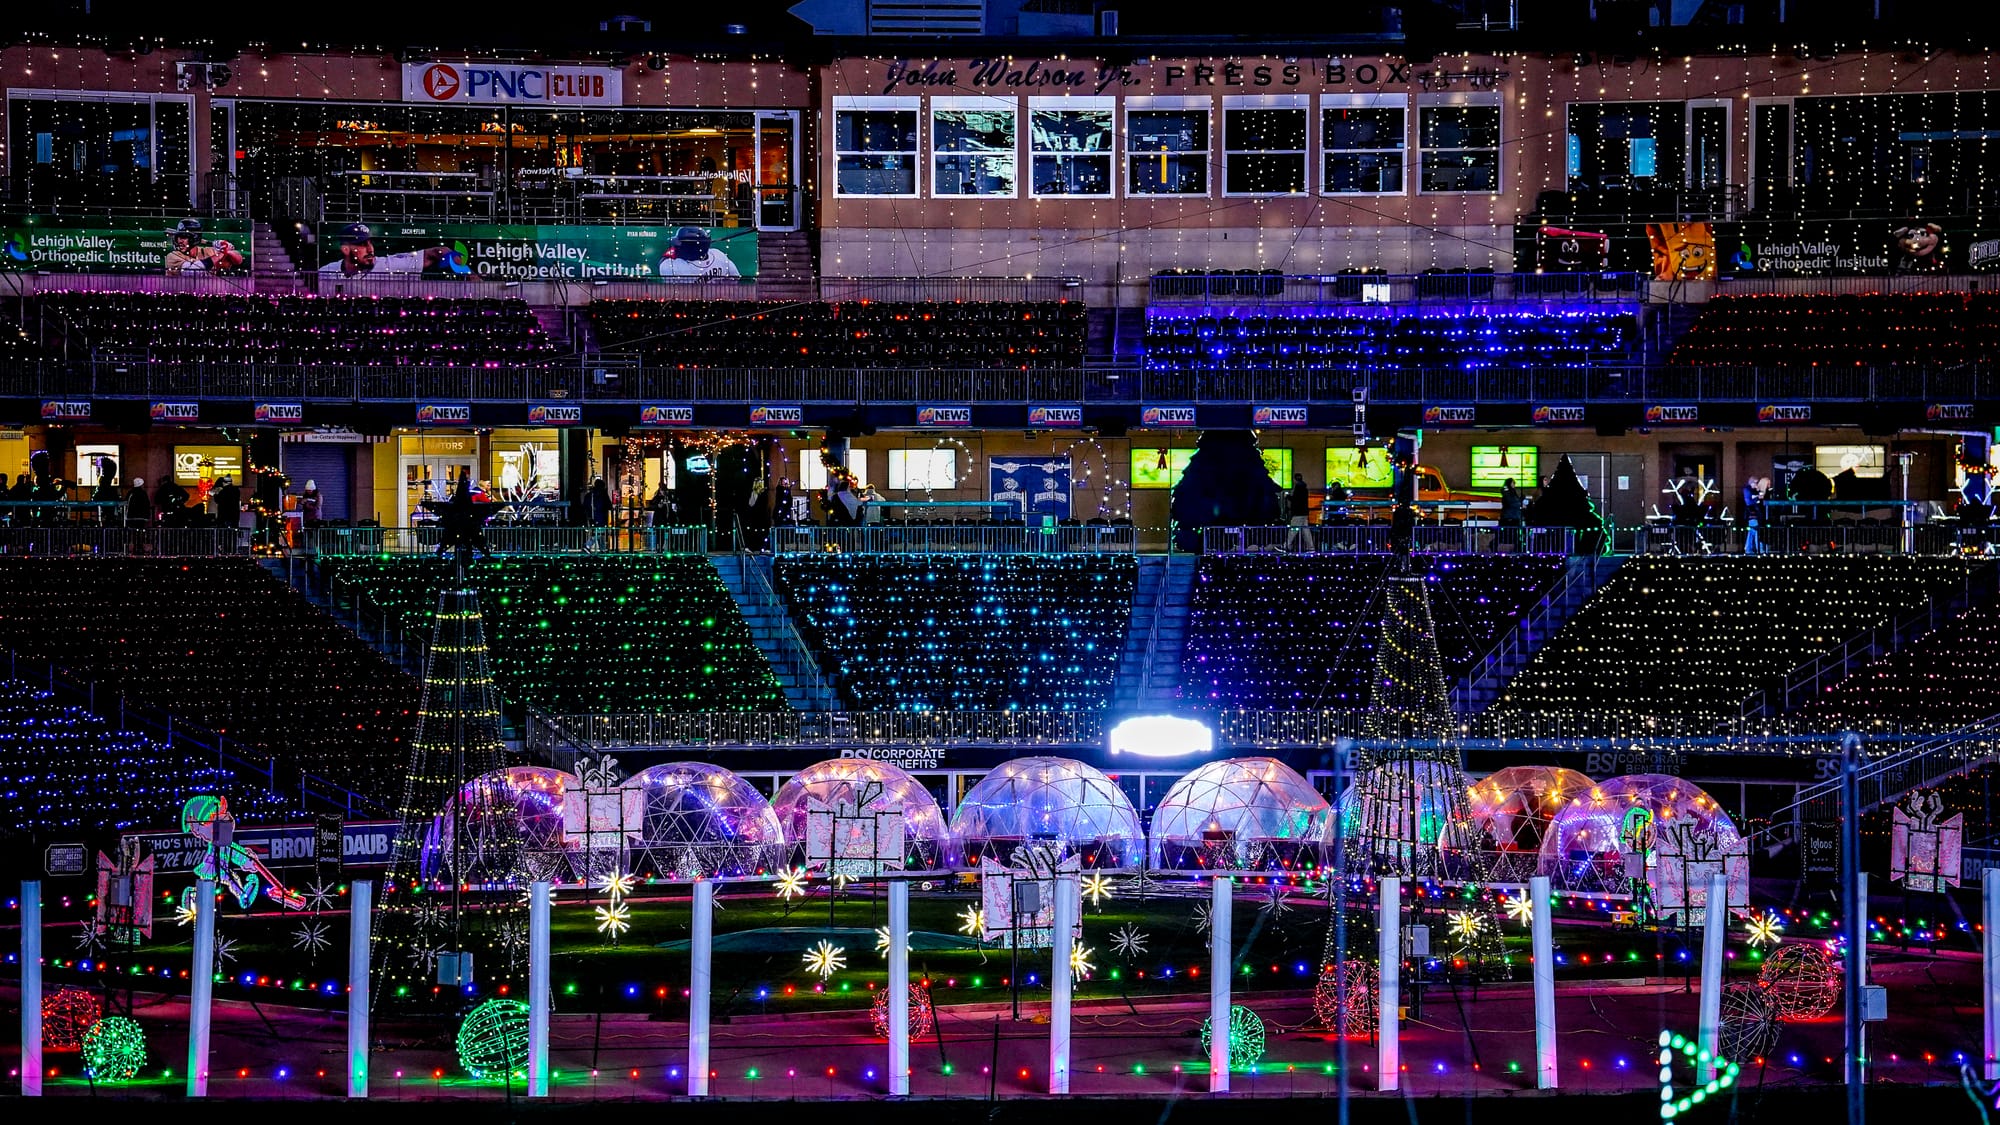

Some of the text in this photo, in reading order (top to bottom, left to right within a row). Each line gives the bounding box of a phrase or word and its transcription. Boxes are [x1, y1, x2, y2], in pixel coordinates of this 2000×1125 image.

[881, 58, 1142, 96] John Walson Jr.
[1165, 63, 1410, 87] PRESS BOX
[464, 69, 604, 99] PNC CLUB
[31, 235, 114, 250] Lehigh Valley
[31, 249, 161, 264] Orthopedic Institute
[476, 242, 587, 262] Lehigh Valley
[1757, 243, 1840, 257] Lehigh Valley
[477, 261, 652, 278] Orthopedic Institute
[1757, 256, 1889, 270] Orthopedic Institute
[57, 403, 90, 416] NEWS
[165, 404, 198, 417] NEWS
[269, 406, 301, 418] NEWS
[433, 407, 468, 420] NEWS
[546, 408, 580, 420] NEWS
[658, 408, 691, 420] NEWS
[766, 409, 800, 421] NEWS
[934, 409, 970, 421] NEWS
[1046, 409, 1080, 421] NEWS
[1159, 409, 1194, 421] NEWS
[1271, 409, 1306, 421] NEWS
[1440, 408, 1474, 420] NEWS
[1549, 408, 1584, 420] NEWS
[1661, 407, 1697, 420] NEWS
[1774, 407, 1810, 419] NEWS
[872, 749, 946, 759] CORPORATE
[1618, 753, 1688, 765] CORPORATE
[1586, 752, 1618, 773] BSI
[1625, 763, 1681, 775] BENEFITS
[343, 834, 388, 856] DAUB
[1810, 836, 1833, 855] Igloos
